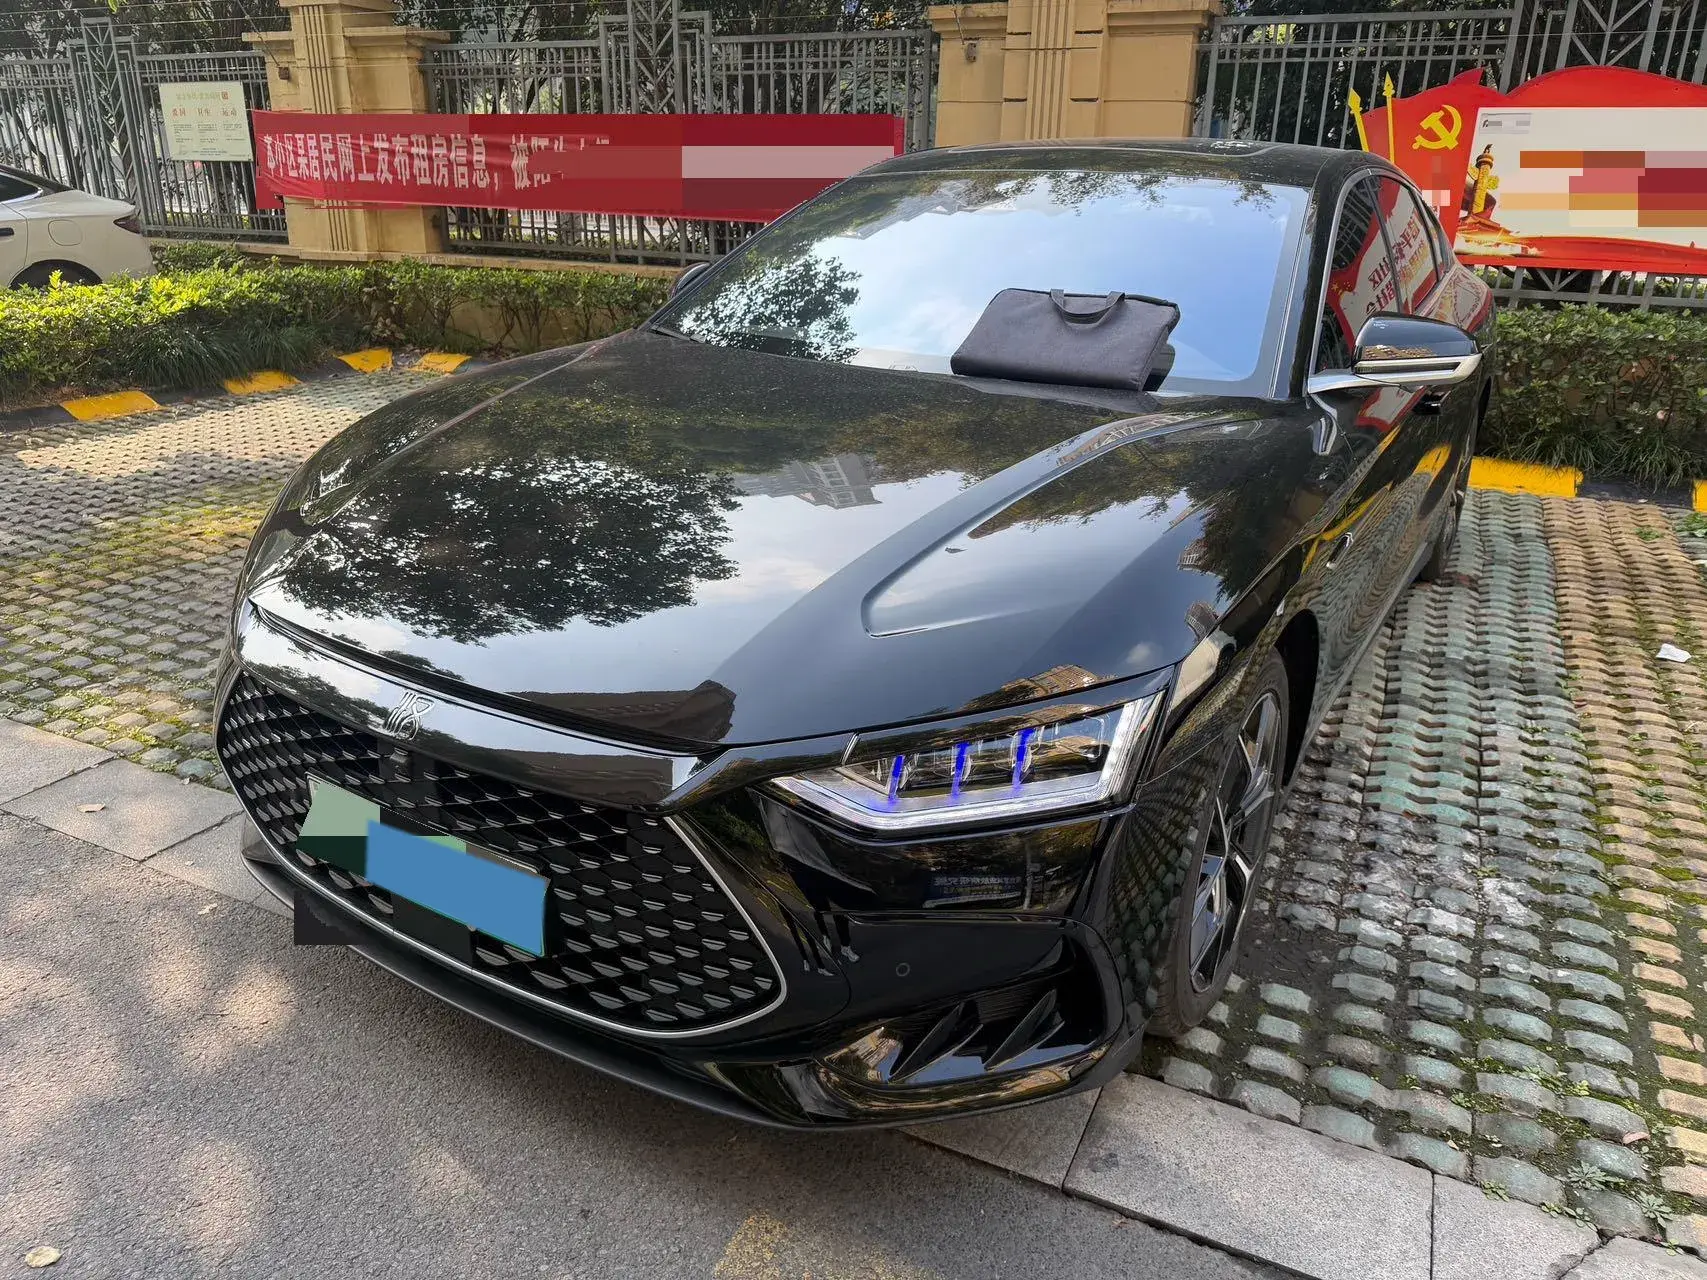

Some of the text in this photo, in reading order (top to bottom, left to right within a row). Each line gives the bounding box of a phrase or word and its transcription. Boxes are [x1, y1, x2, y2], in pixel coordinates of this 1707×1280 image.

[263, 132, 609, 190] 本小区某居民网上发布租房信息，被
